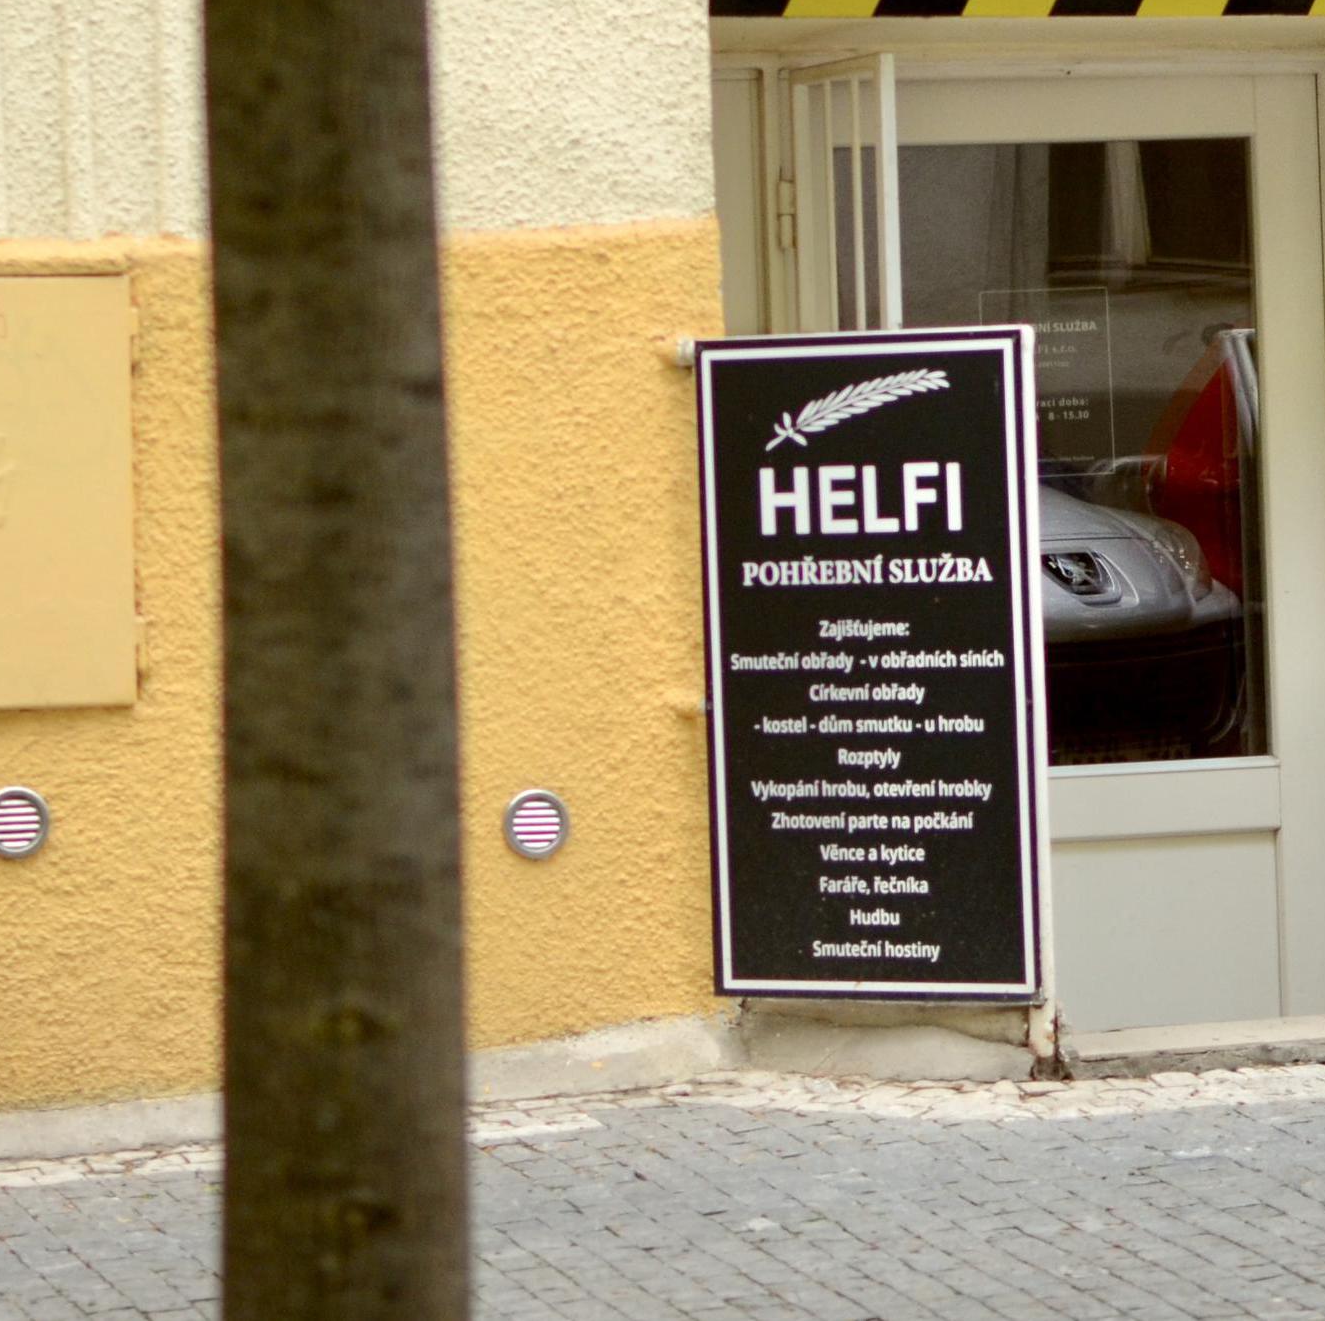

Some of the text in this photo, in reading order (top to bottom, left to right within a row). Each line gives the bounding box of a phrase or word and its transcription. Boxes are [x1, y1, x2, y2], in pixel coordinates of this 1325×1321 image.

[1054, 320, 1097, 332] SLUŽBA
[759, 461, 963, 536] HELFI
[742, 552, 993, 587] POHŘEBNÍ SLUŽBA
[819, 620, 910, 640] Zajišťujeme:
[731, 651, 798, 670] Smuteční
[801, 652, 854, 673] obřady
[869, 656, 878, 668] v
[881, 650, 957, 668] obřadních
[960, 649, 1004, 667] síních
[809, 684, 925, 704] Církevní obřady
[763, 716, 807, 734] kostel
[818, 715, 853, 733] dům
[856, 716, 912, 733] smutku
[924, 719, 935, 732] u
[938, 714, 984, 732] hrobu
[838, 749, 901, 769] Rozptyly
[751, 780, 992, 801] Vykopání hrobu, otevření hrobky
[772, 812, 973, 832] Zhotovení parte na počkání
[820, 844, 925, 865] Věnce a kytice
[819, 875, 928, 895] Faráře, řečníka
[849, 909, 900, 926] Hudbu
[813, 940, 940, 962] Smuteční hostiny
